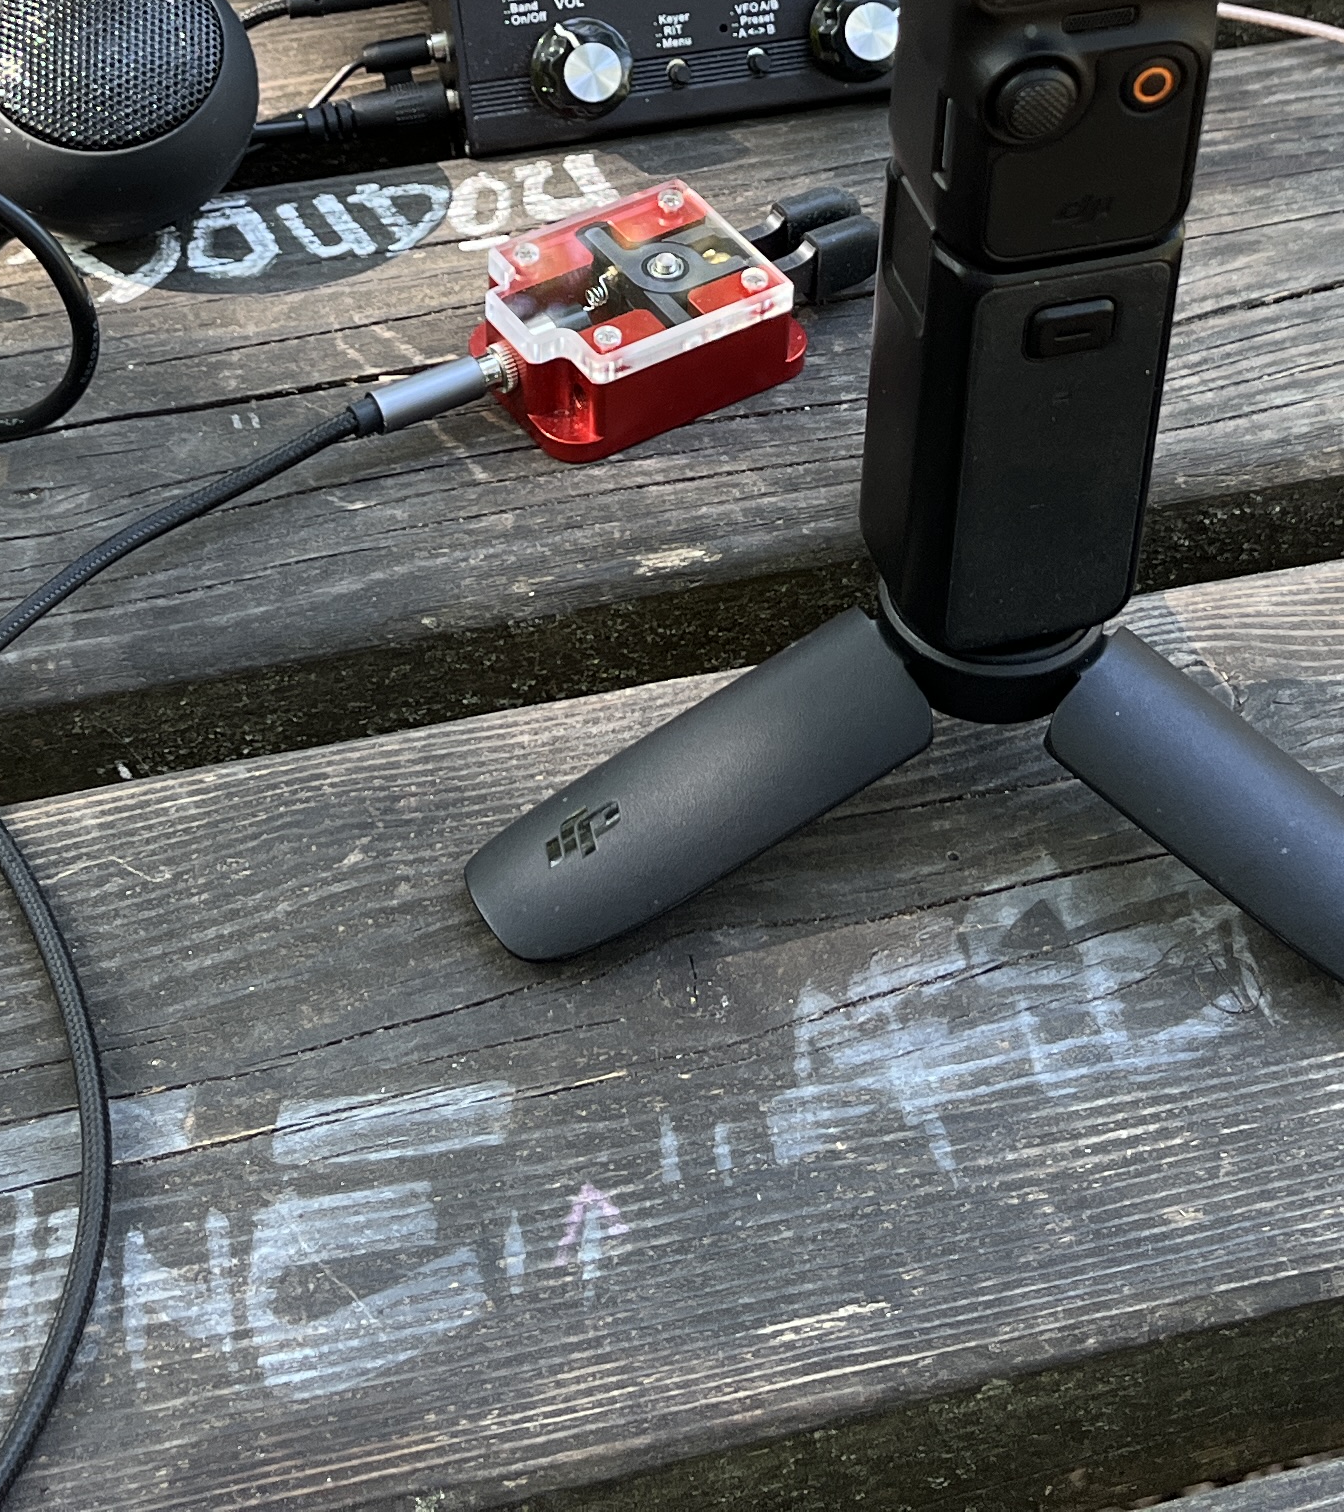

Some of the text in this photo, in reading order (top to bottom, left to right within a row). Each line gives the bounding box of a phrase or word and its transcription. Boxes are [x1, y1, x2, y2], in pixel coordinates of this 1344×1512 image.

[509, 1, 539, 14] Band
[734, 0, 758, 16] VFO
[510, 10, 548, 26] On/Off
[658, 11, 691, 27] Keyer
[739, 12, 775, 27] Preset
[663, 24, 683, 36] RIT
[662, 37, 693, 49] Menu
